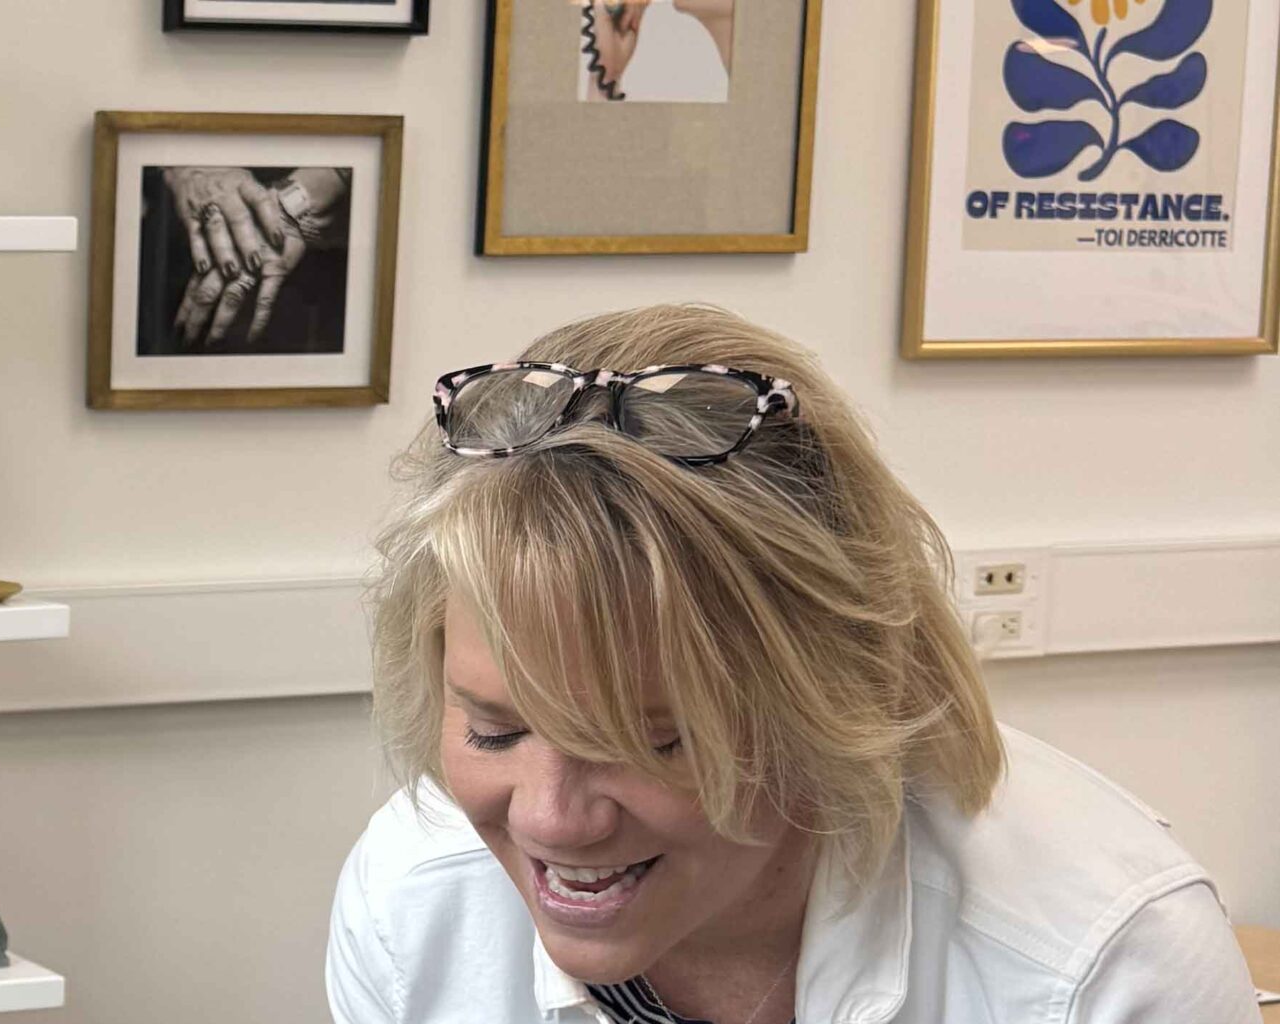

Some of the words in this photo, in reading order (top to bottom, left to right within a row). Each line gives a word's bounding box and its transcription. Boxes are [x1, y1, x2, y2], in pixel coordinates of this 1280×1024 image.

[965, 190, 1010, 219] OF
[1014, 191, 1230, 222] RESISTANCE.
[1126, 229, 1228, 248] DERRICOTTE
